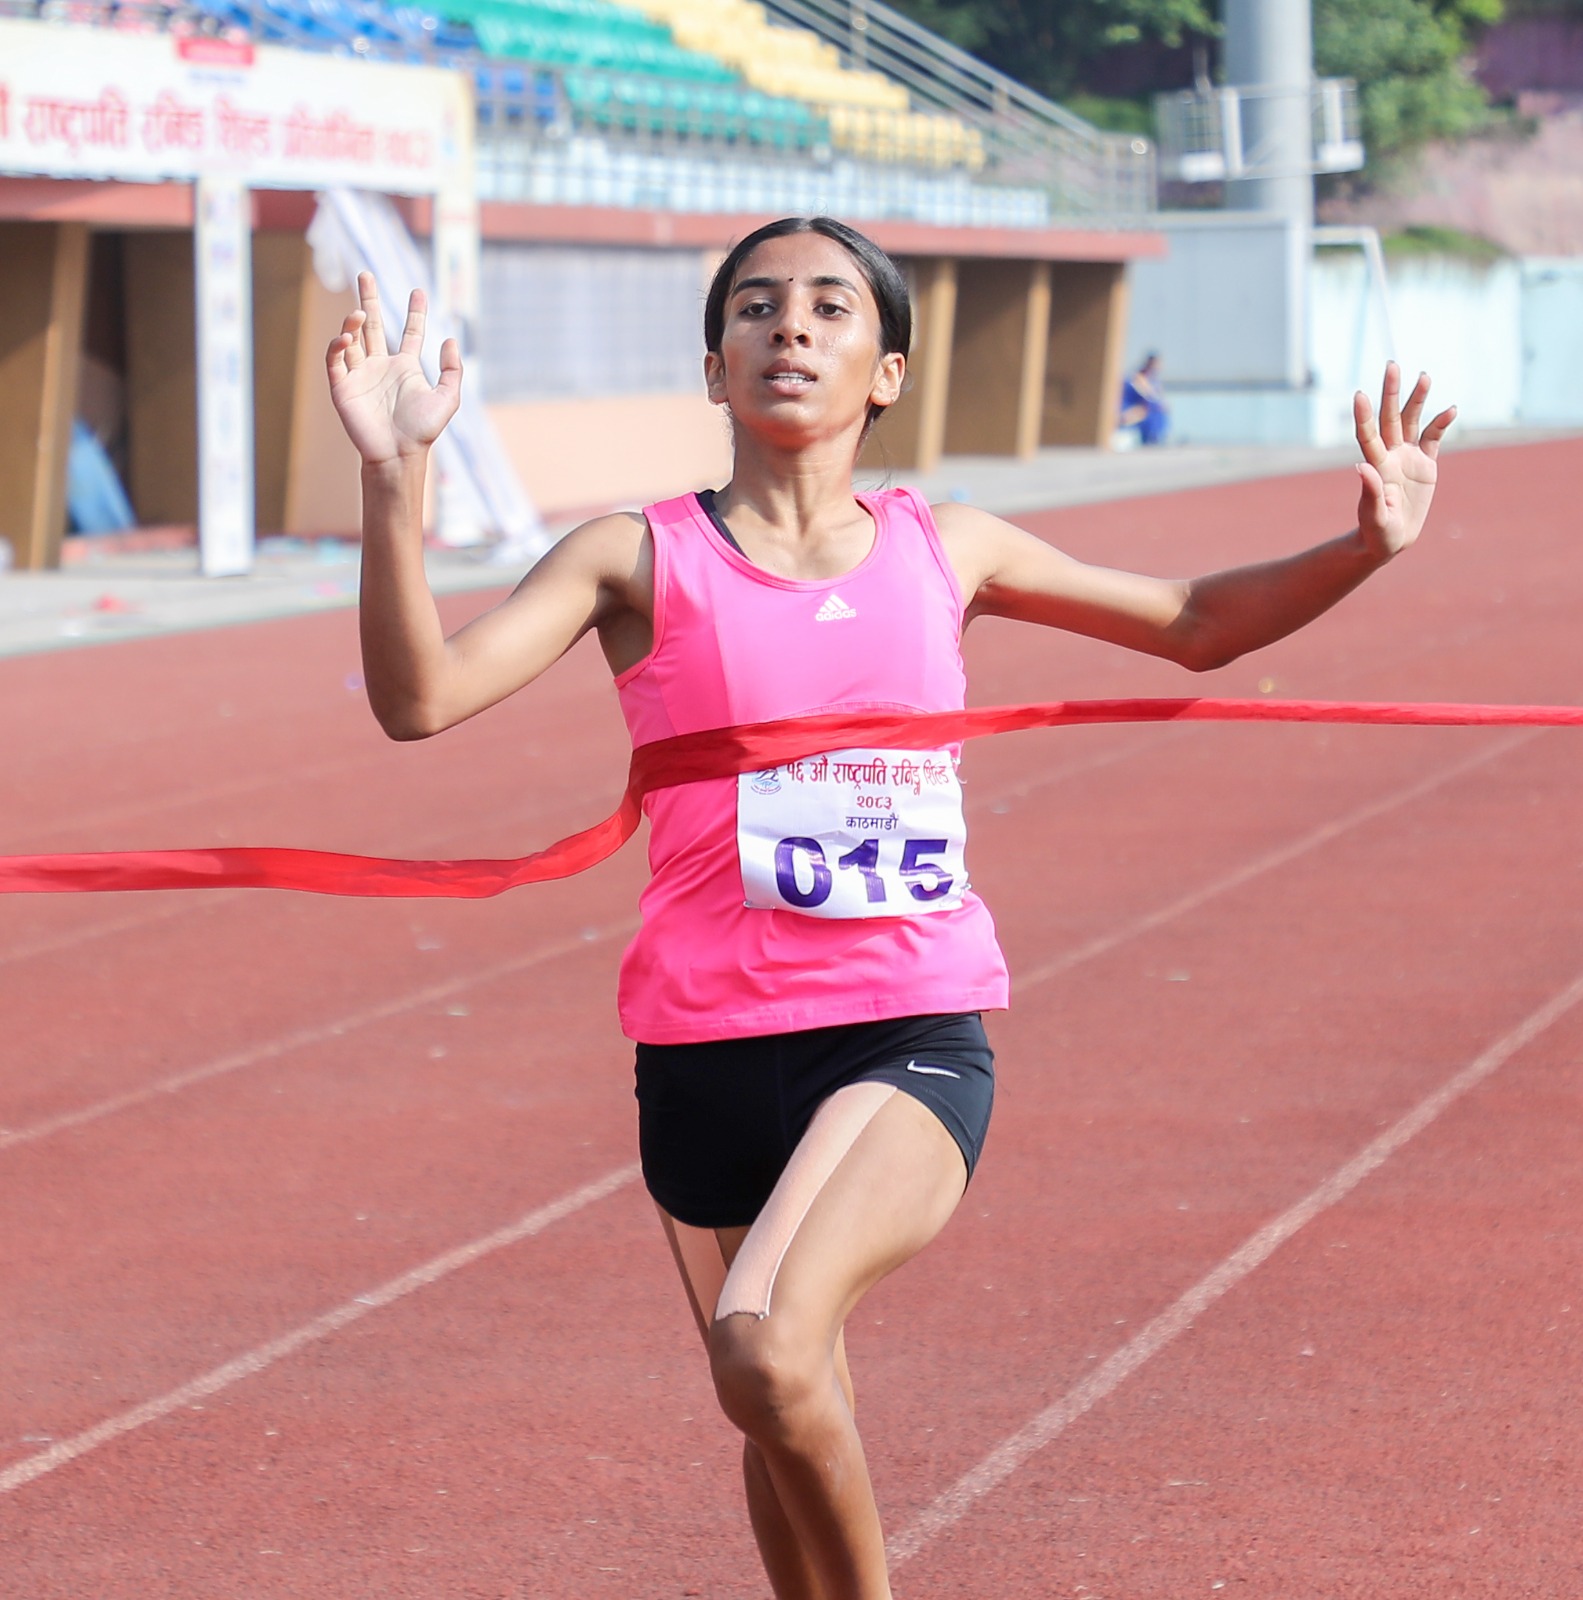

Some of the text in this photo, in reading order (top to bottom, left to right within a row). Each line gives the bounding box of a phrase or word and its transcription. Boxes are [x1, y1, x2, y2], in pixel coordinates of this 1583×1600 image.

[815, 608, 857, 622] adidas
[786, 762, 804, 783] १६
[833, 757, 888, 790] राष्ट्रपति
[856, 795, 892, 810] २०८३
[774, 836, 953, 908] 015
